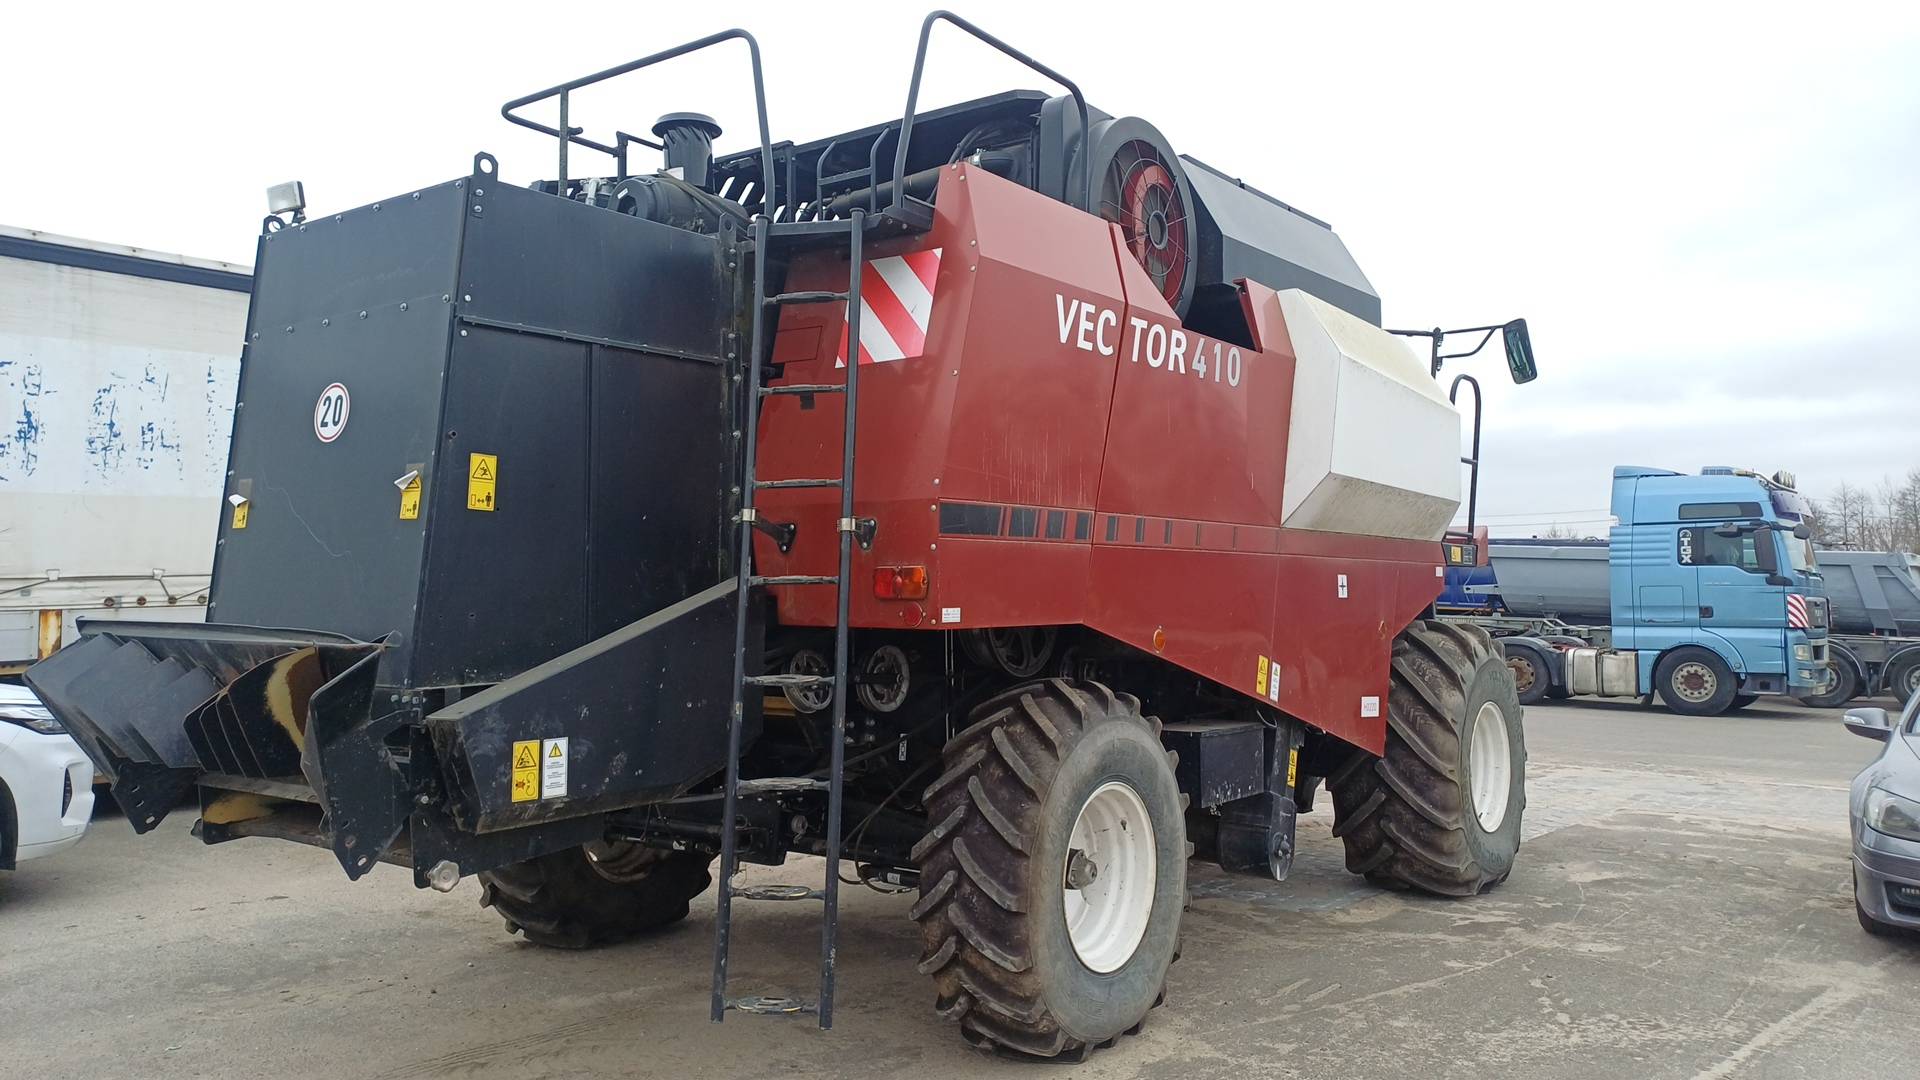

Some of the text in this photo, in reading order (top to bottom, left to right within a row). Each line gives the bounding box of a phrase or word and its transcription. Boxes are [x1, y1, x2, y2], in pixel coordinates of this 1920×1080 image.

[1191, 337, 1241, 387] 410
[320, 394, 344, 428] 20
[1680, 537, 1693, 564] TGX
